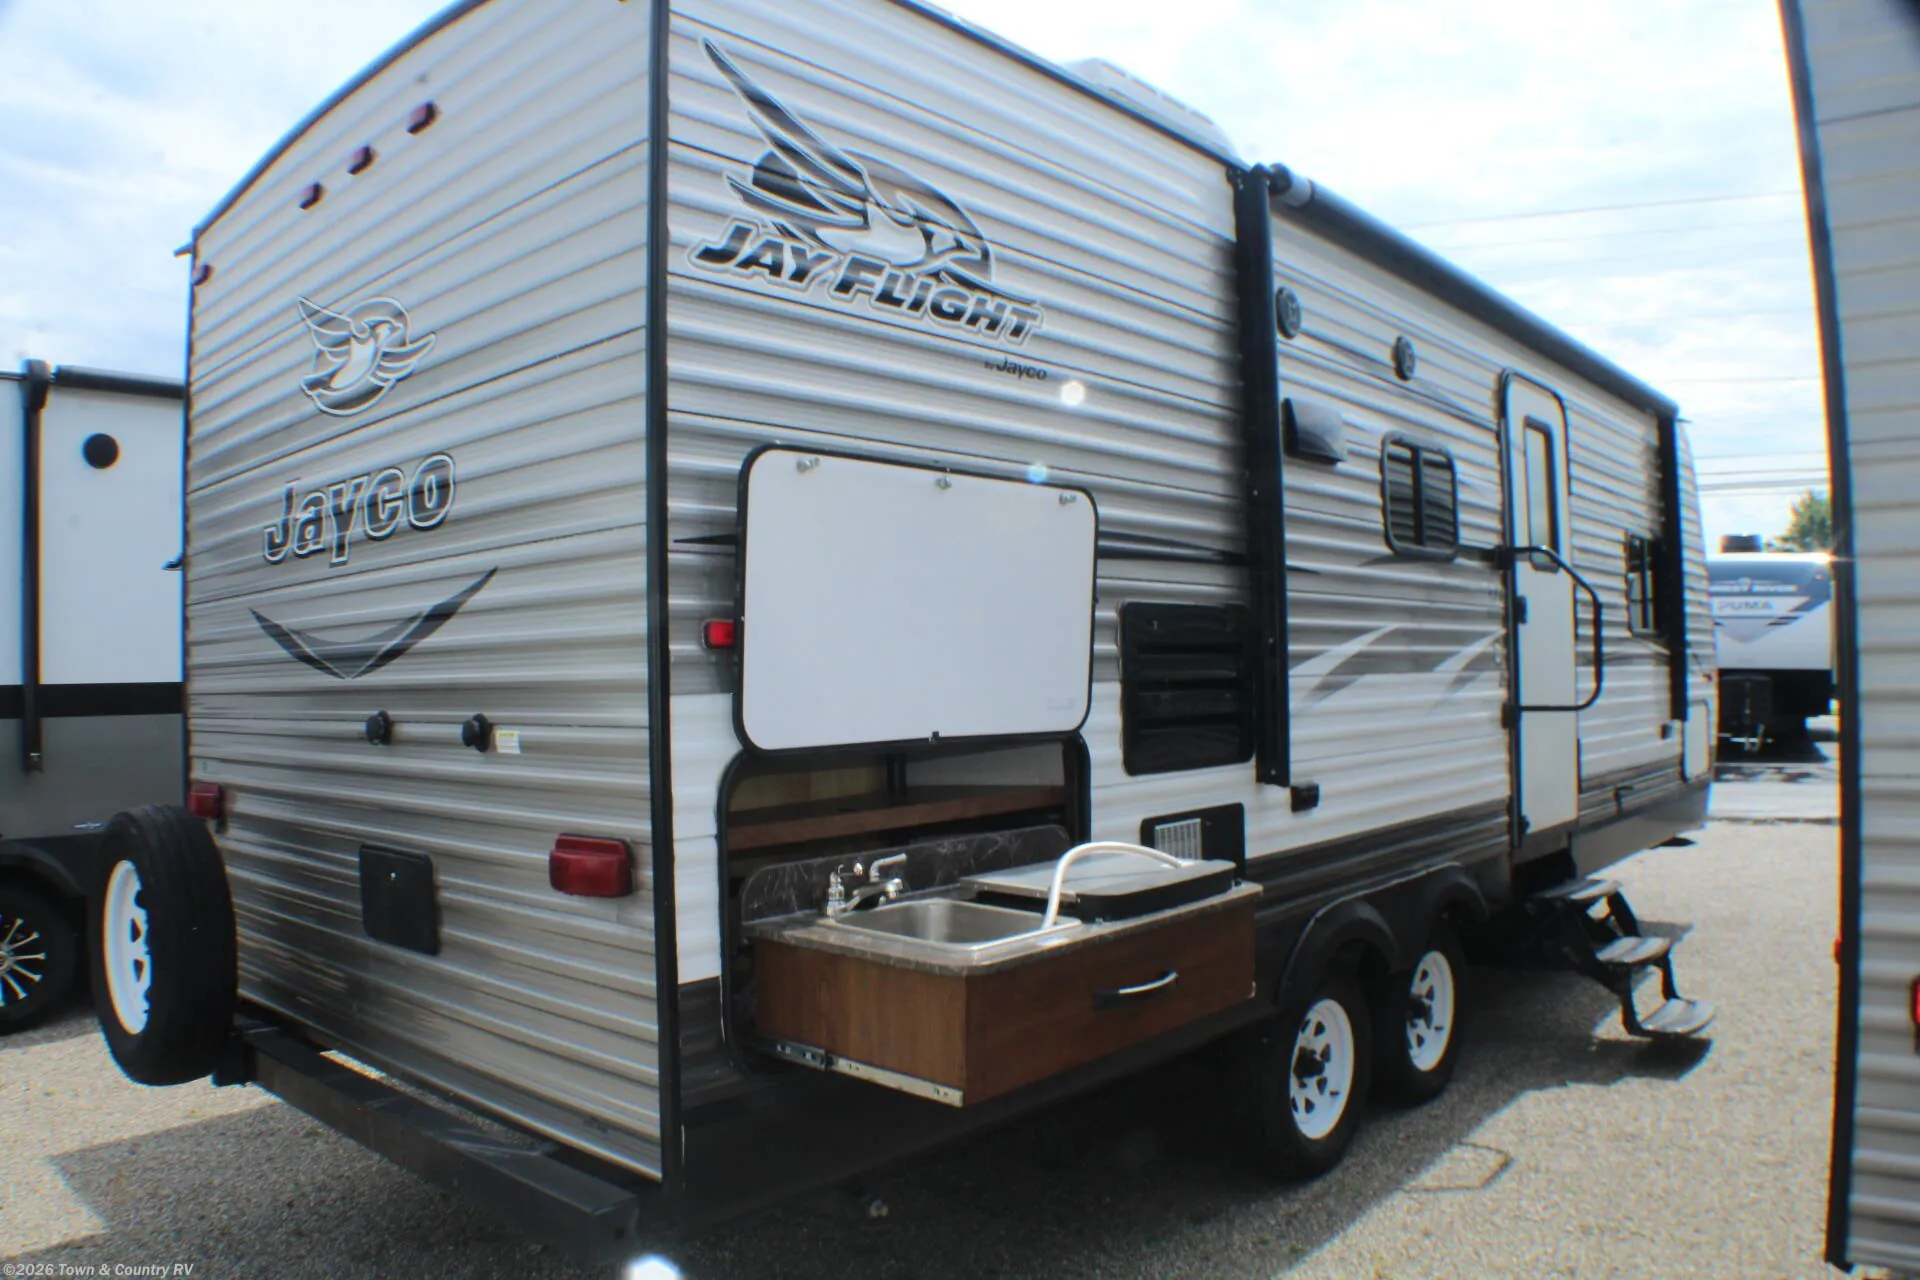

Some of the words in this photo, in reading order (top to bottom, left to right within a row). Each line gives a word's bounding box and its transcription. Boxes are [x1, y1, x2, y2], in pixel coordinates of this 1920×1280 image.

[692, 221, 838, 287] JAY
[831, 253, 1042, 341] FLIGHT
[996, 356, 1047, 380] Jayco
[263, 452, 456, 568] Jayco
[1717, 600, 1774, 612] PUMA
